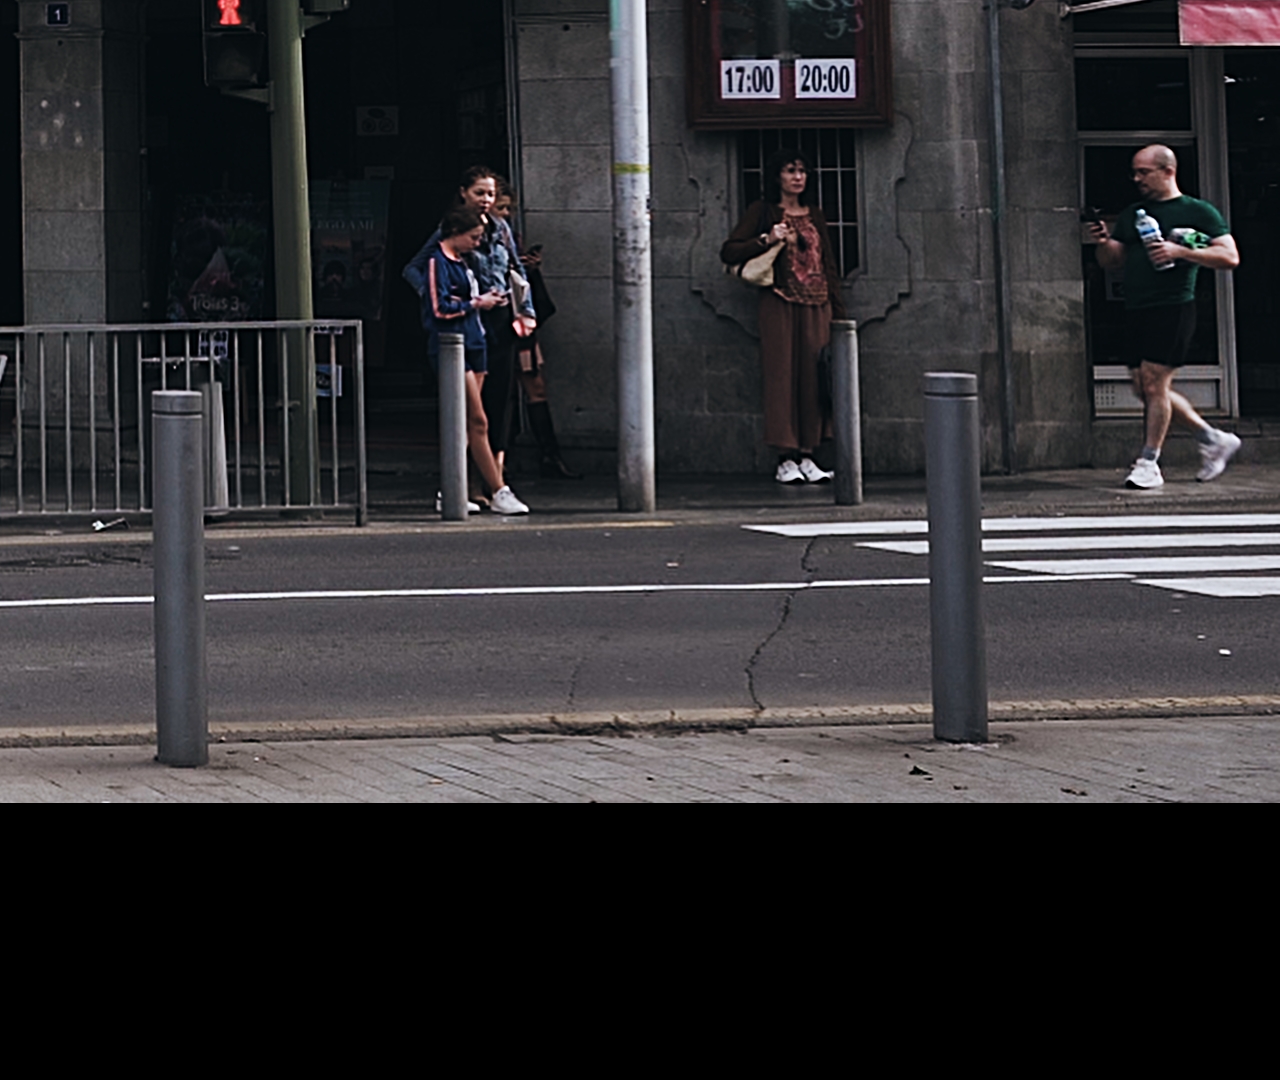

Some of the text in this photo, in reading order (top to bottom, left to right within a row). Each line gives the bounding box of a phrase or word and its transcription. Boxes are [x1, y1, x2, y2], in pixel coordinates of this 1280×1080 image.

[54, 8, 61, 21] 1
[724, 65, 851, 93] 17:00 20:00
